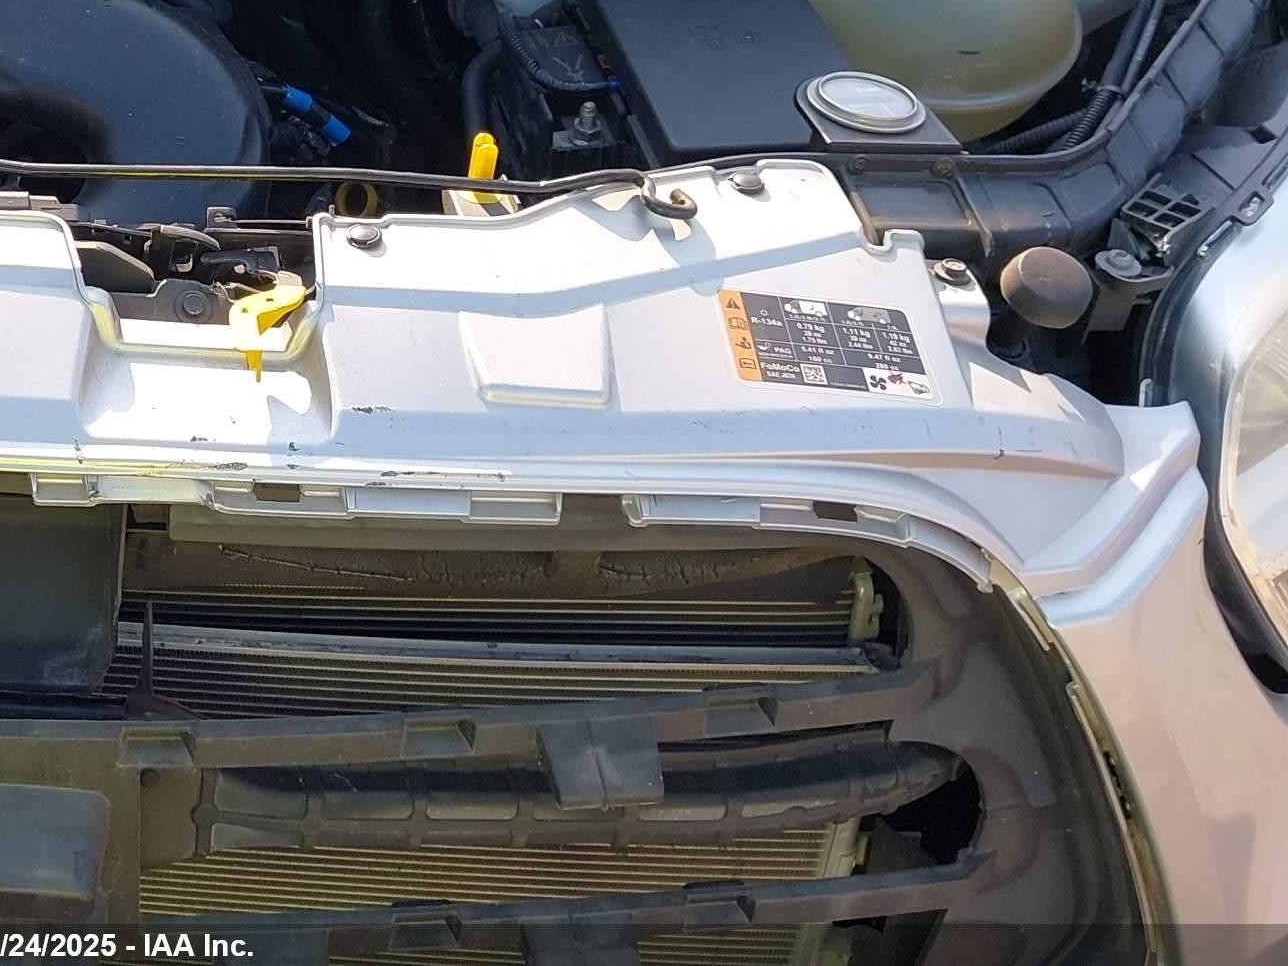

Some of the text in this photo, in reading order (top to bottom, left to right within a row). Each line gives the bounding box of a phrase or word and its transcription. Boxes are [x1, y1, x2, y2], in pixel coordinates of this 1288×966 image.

[751, 316, 782, 326] R-134a
[814, 325, 825, 334] kg
[860, 330, 871, 338] kg
[899, 334, 910, 343] kg
[774, 346, 792, 354] PAG
[760, 362, 800, 372] FoMoCo
